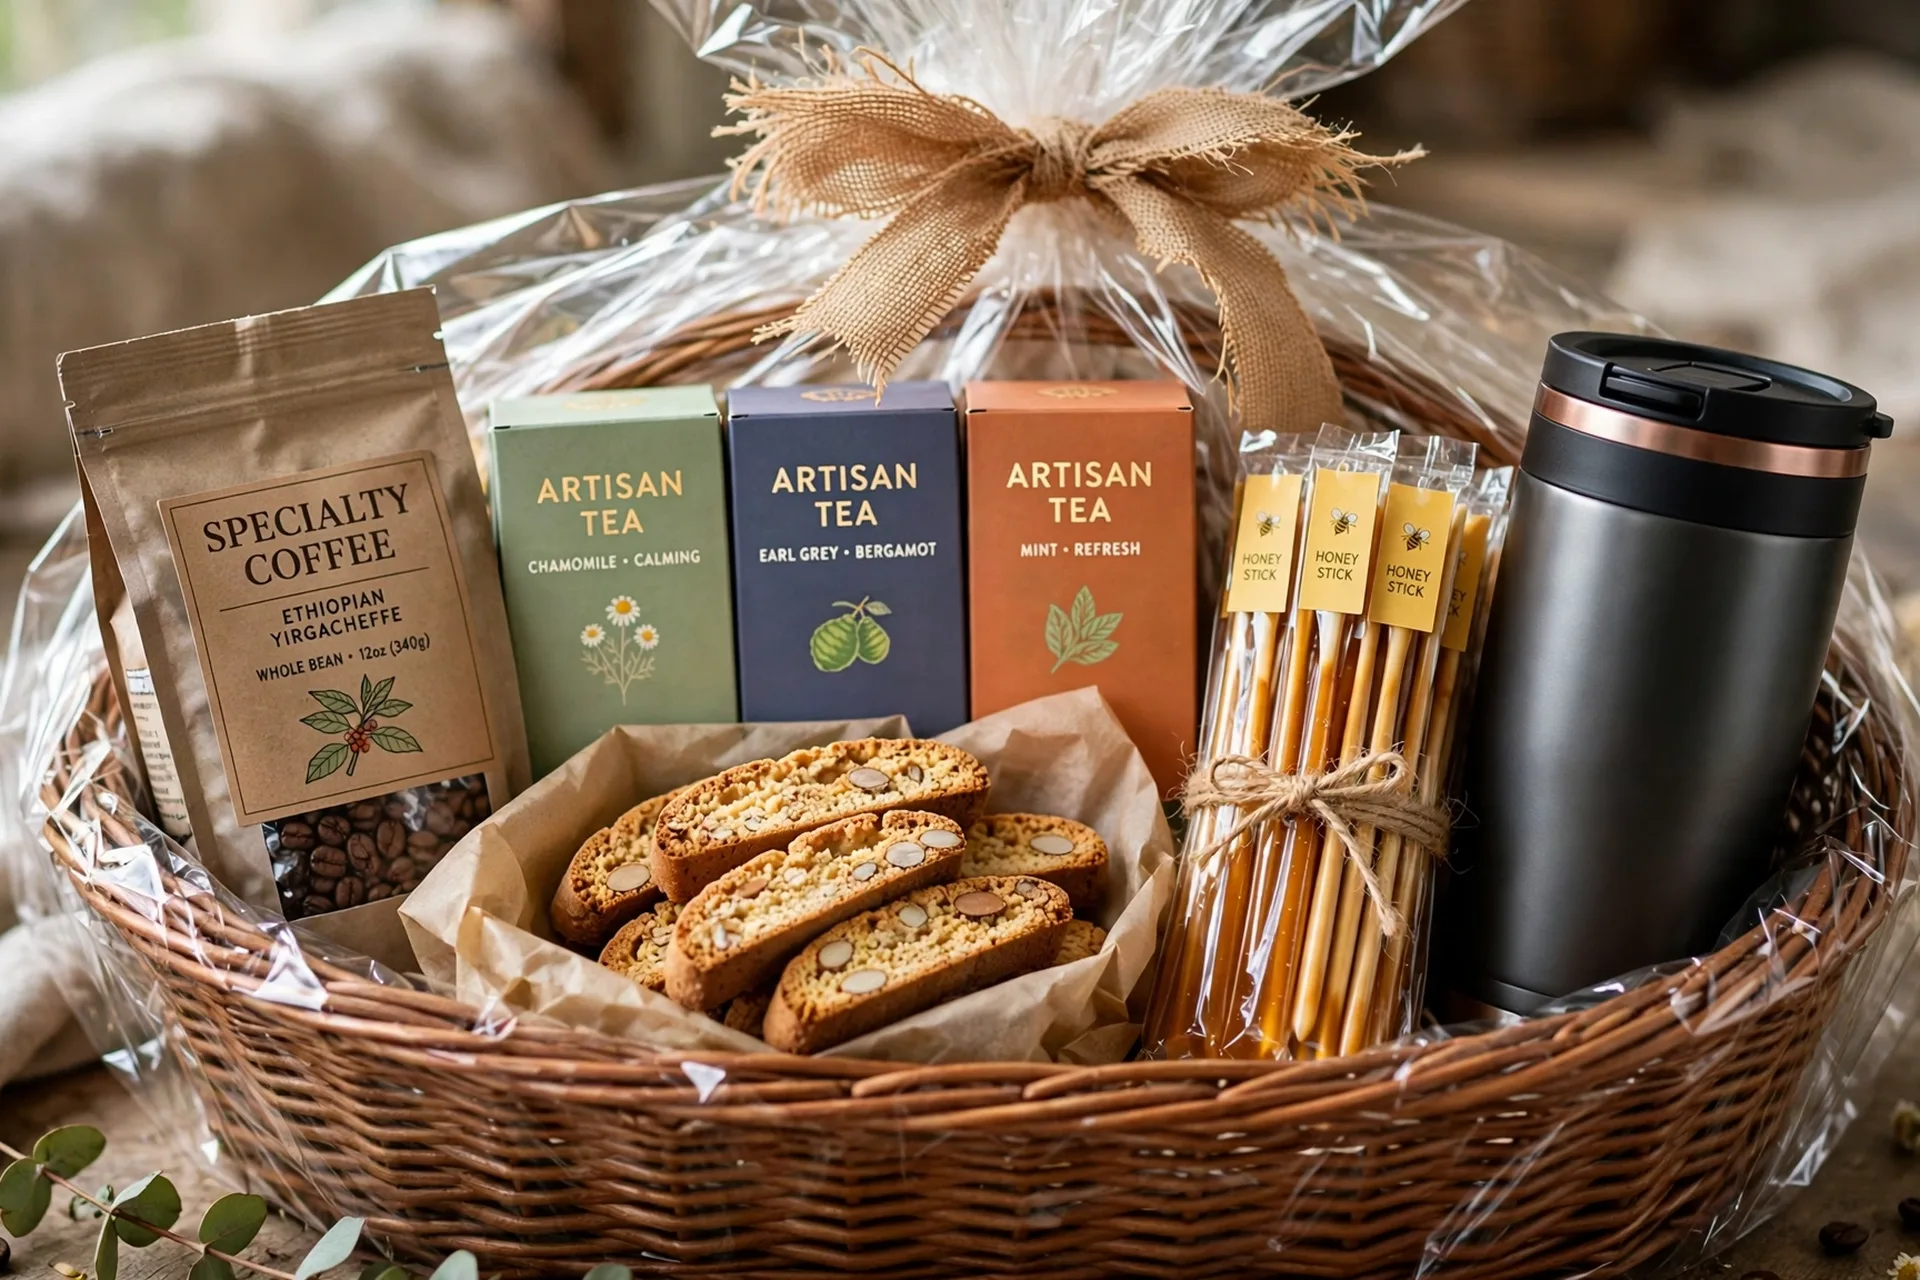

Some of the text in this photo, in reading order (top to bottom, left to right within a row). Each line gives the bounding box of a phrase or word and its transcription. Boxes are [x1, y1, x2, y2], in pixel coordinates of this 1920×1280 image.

[537, 470, 683, 504] ARTISAN
[771, 463, 918, 494] ARTISAN
[1006, 461, 1152, 488] ARTISAN
[203, 483, 410, 553] SPECIALTY
[580, 508, 644, 536] TEA
[814, 500, 878, 527] TEA
[1048, 497, 1112, 523] TEA
[244, 528, 397, 586] COFFEE
[528, 549, 701, 574] CHAMOMILE CALMING
[759, 542, 937, 563] EARL GREY BERGAMOT
[1020, 541, 1141, 557] MINT REFRESH
[1242, 553, 1282, 565] HONEY
[1315, 551, 1359, 567] HONEY
[1243, 568, 1277, 581] STICK
[1317, 567, 1353, 581] STICK
[1386, 564, 1432, 583] HONEY
[1387, 581, 1424, 598] STICK
[282, 588, 386, 625] ETHIOPIAN
[270, 606, 403, 648] YIRGACHEFFE
[256, 632, 431, 682] WHOLE BEAN 12oz (340g)
